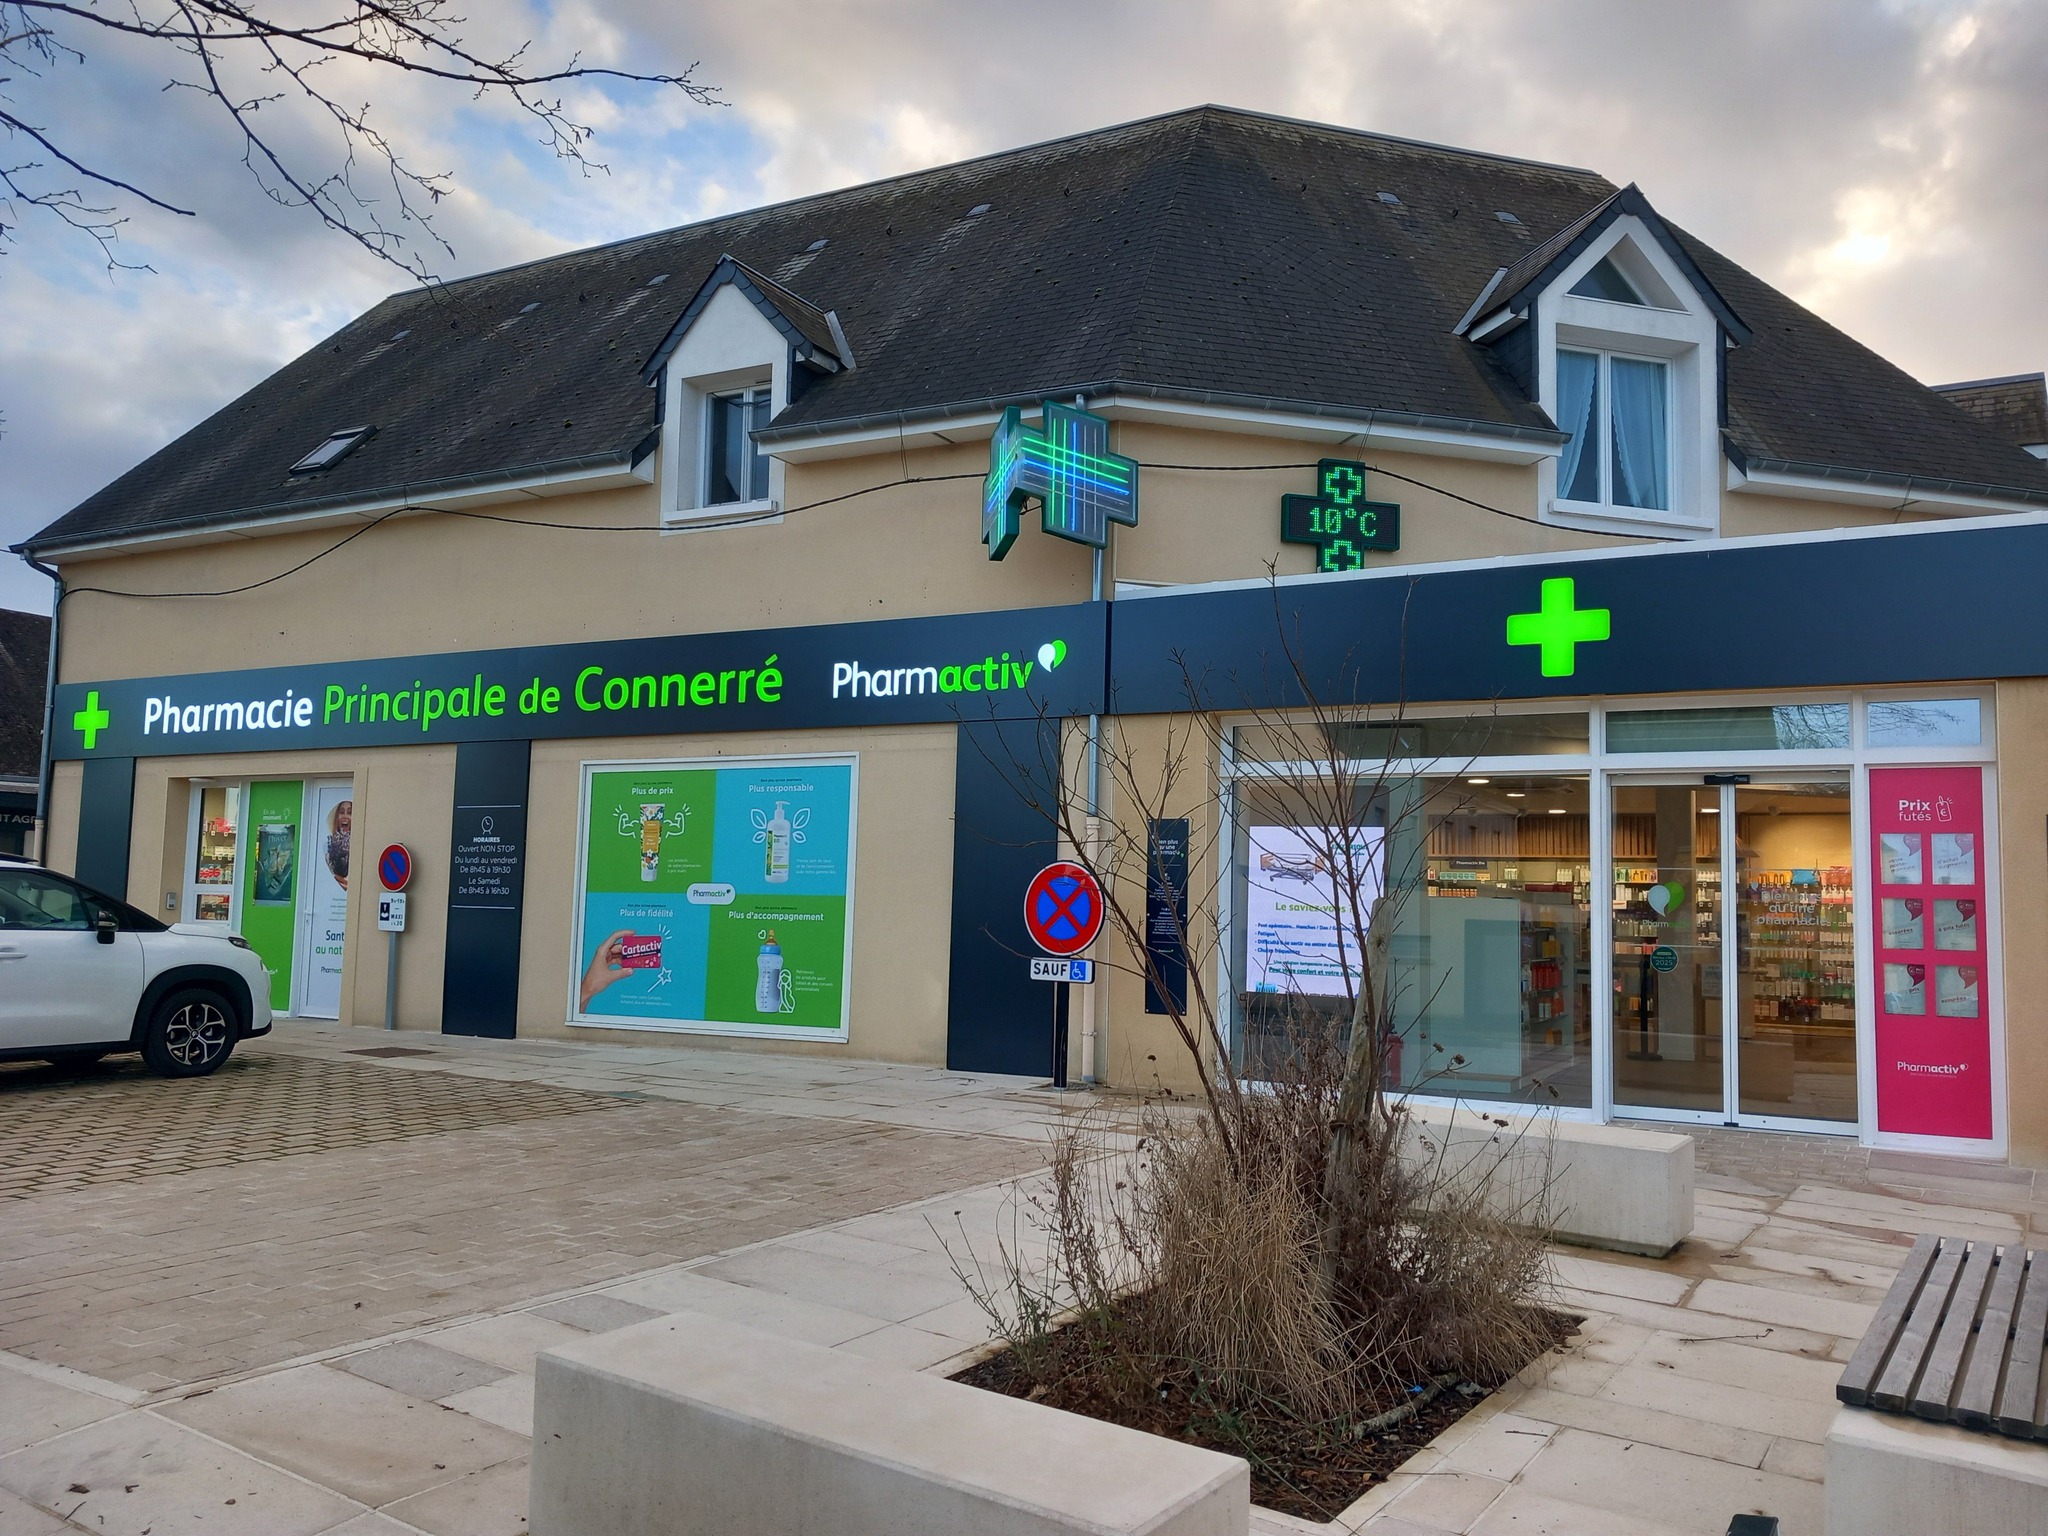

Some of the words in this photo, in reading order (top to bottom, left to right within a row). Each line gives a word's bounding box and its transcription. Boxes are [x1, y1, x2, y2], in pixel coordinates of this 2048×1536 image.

[1309, 507, 1377, 538] 10°C
[832, 652, 1034, 699] Pharmactiv
[143, 689, 314, 735] Pharmacie
[322, 673, 506, 732] Principale
[518, 677, 561, 715] de
[574, 653, 783, 712] Connerré
[631, 787, 647, 795] Plus
[648, 787, 658, 795] de
[659, 787, 673, 796] prix
[748, 784, 765, 792] Plus
[766, 783, 814, 793] responsable
[1898, 799, 1931, 811] Prix
[1899, 811, 1932, 821] futés
[464, 856, 479, 864] lundi
[490, 856, 517, 864] vendredi
[692, 889, 726, 897] Pharmactiv
[1275, 902, 1287, 911] Le
[620, 908, 635, 917] Plus
[636, 909, 646, 917] de
[647, 908, 674, 918] fidélité
[746, 911, 824, 921] d'accompagnement
[621, 941, 662, 955] Cartactiv
[1033, 962, 1068, 976] SAUF
[1897, 1060, 1959, 1075] Pharmactiv
